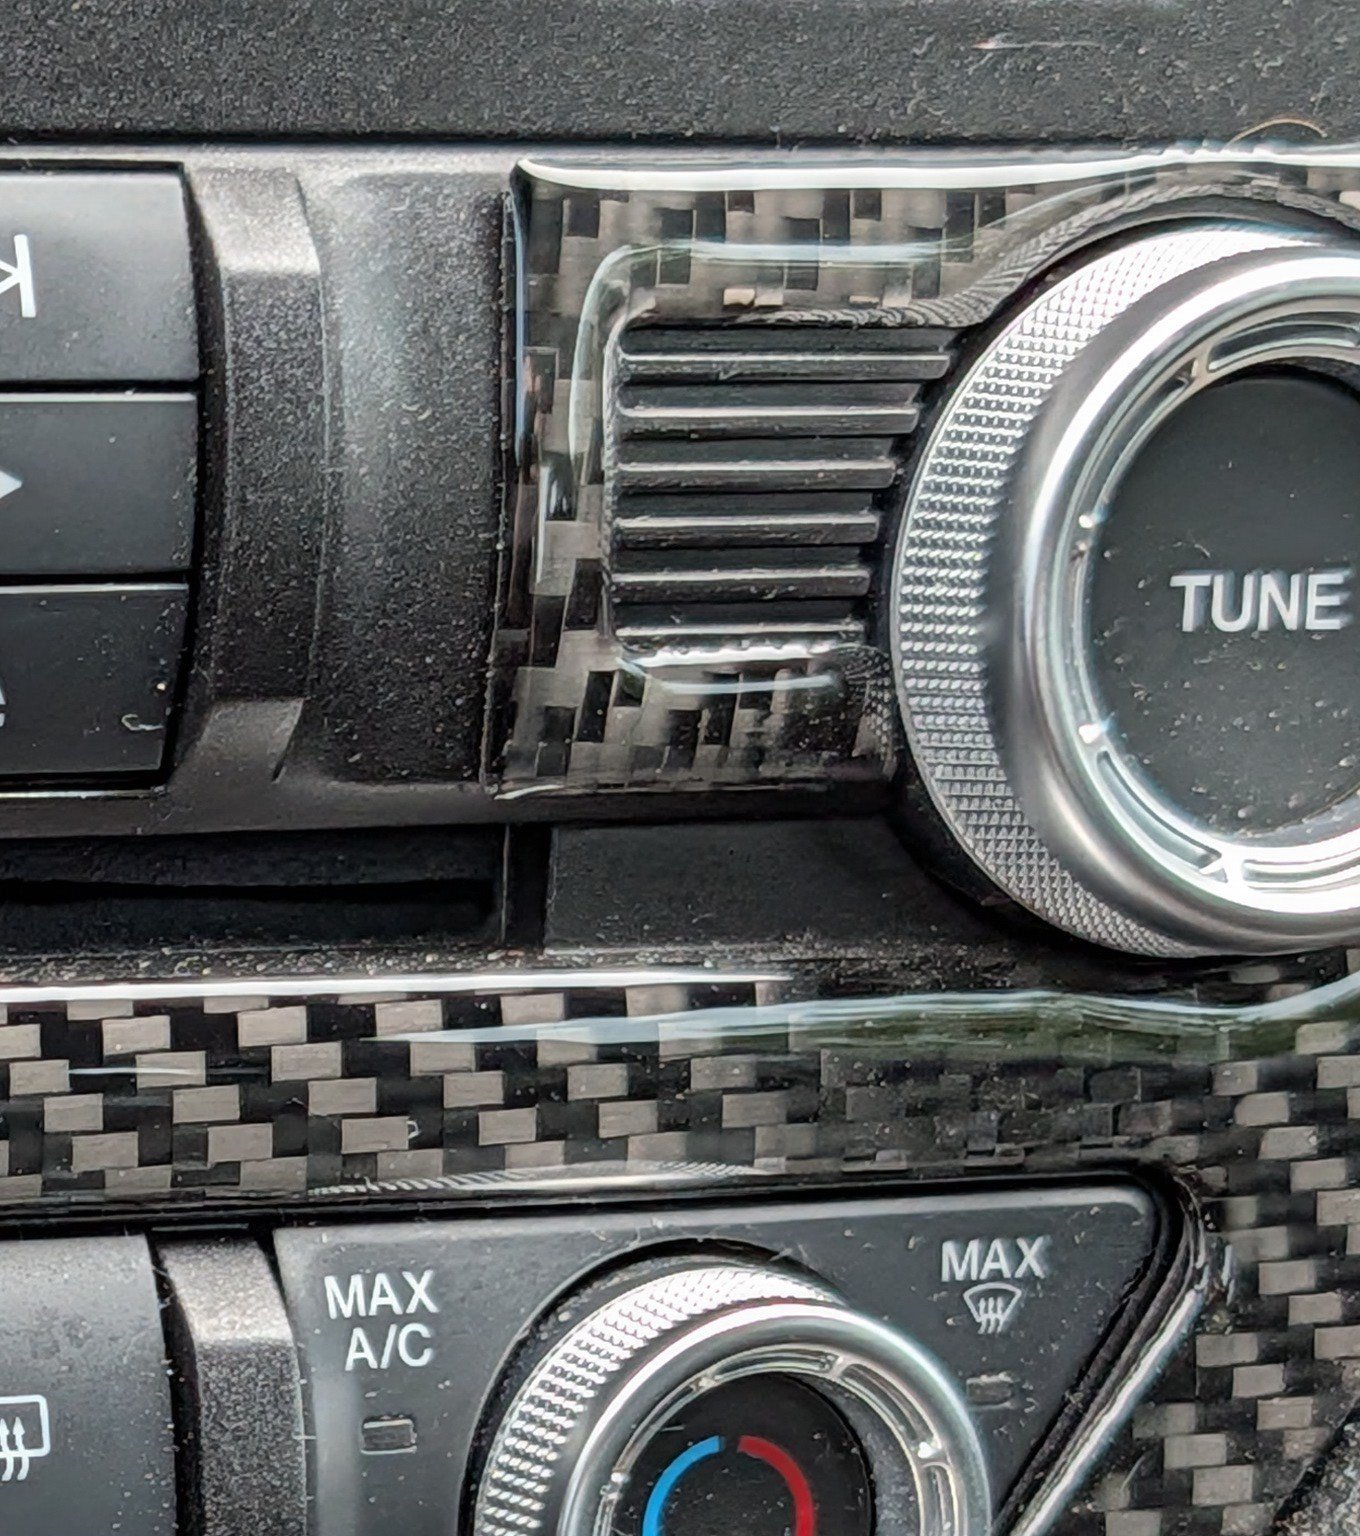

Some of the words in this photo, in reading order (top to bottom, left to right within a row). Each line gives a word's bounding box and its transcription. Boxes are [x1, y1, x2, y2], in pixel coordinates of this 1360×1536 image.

[1169, 571, 1349, 632] TUNE
[941, 1235, 1048, 1282] MAX
[323, 1269, 440, 1320] MAX
[344, 1322, 434, 1371] A/C
